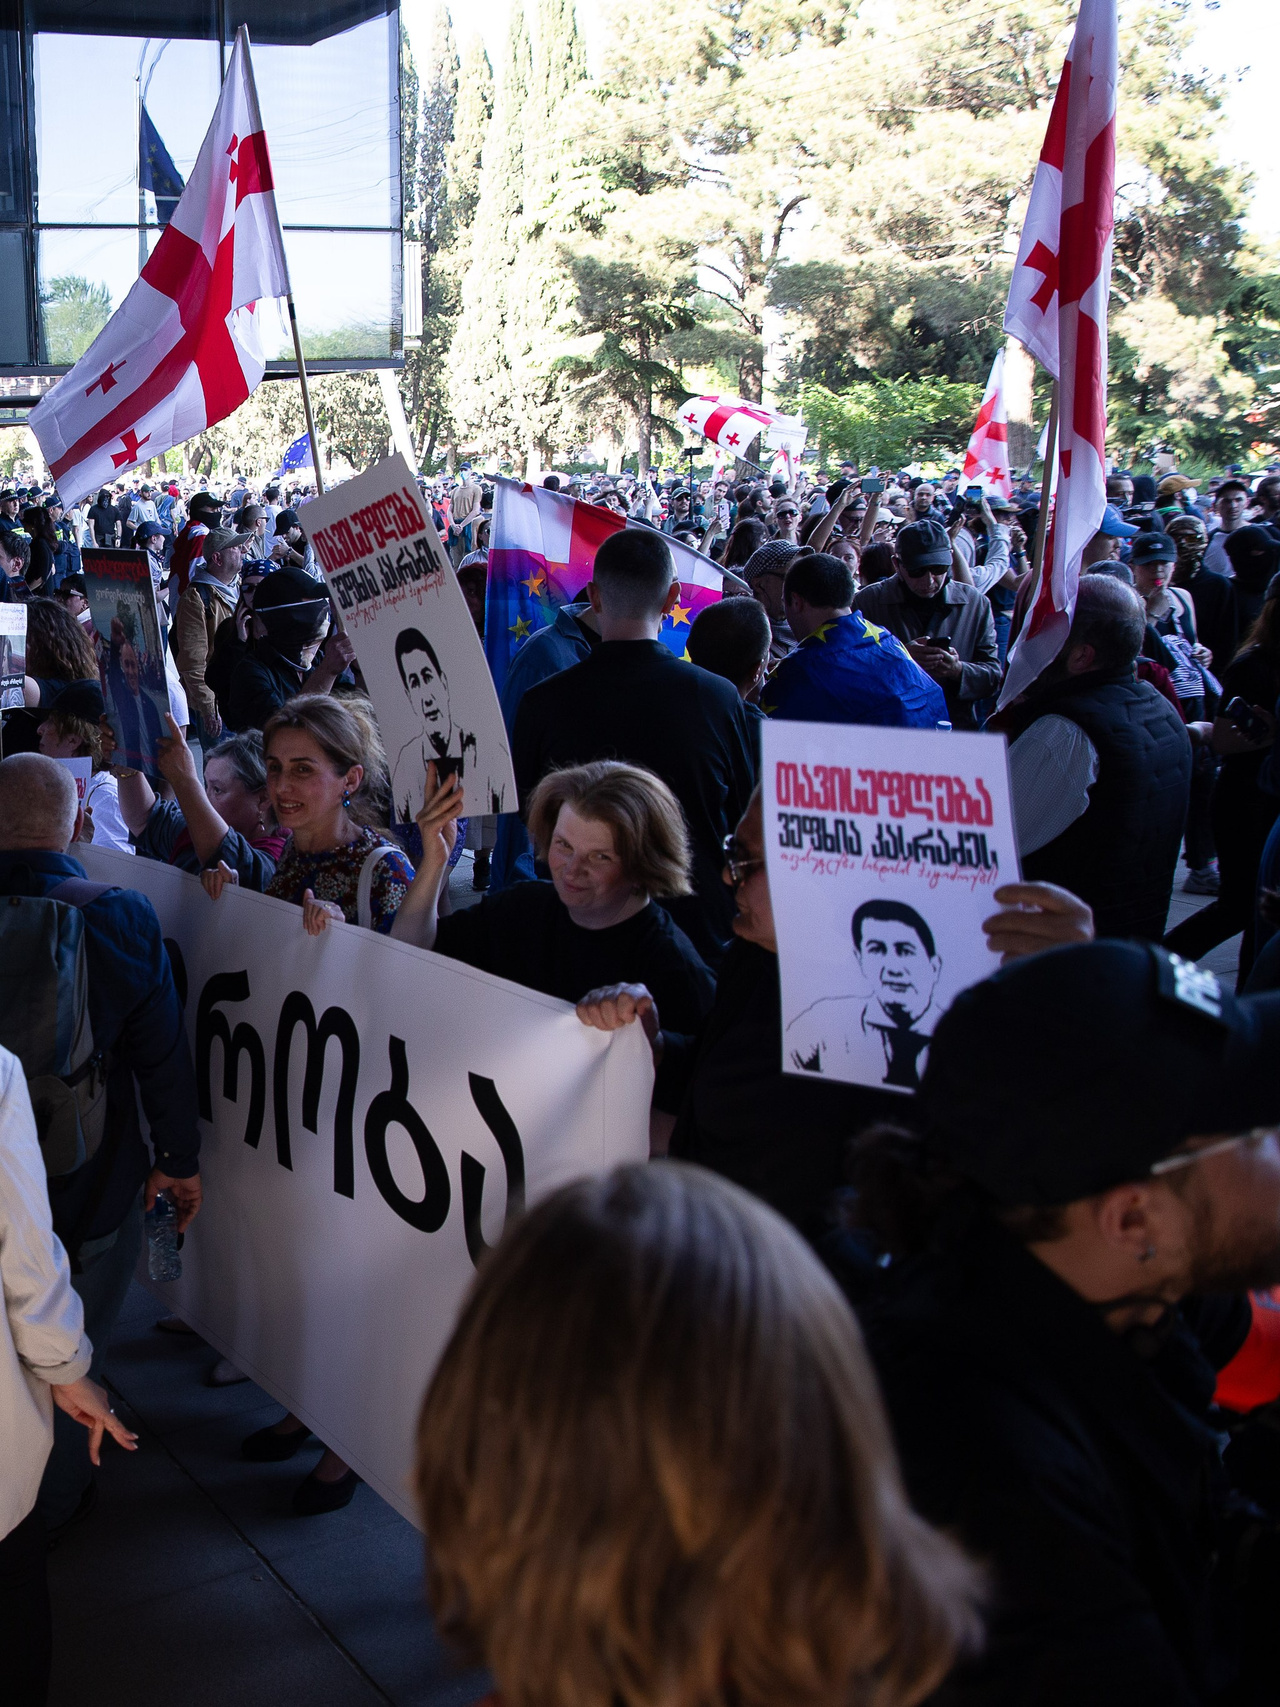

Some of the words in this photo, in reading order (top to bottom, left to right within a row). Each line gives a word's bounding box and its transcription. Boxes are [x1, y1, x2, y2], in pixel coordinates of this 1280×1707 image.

[313, 487, 426, 573] თავისუფლება
[331, 564, 381, 609] ვეფხია
[376, 537, 441, 591] კასრაძეს
[776, 761, 994, 827] თავისუფლება
[778, 812, 862, 856] ვეფხია
[872, 823, 999, 870] კასრაძეს
